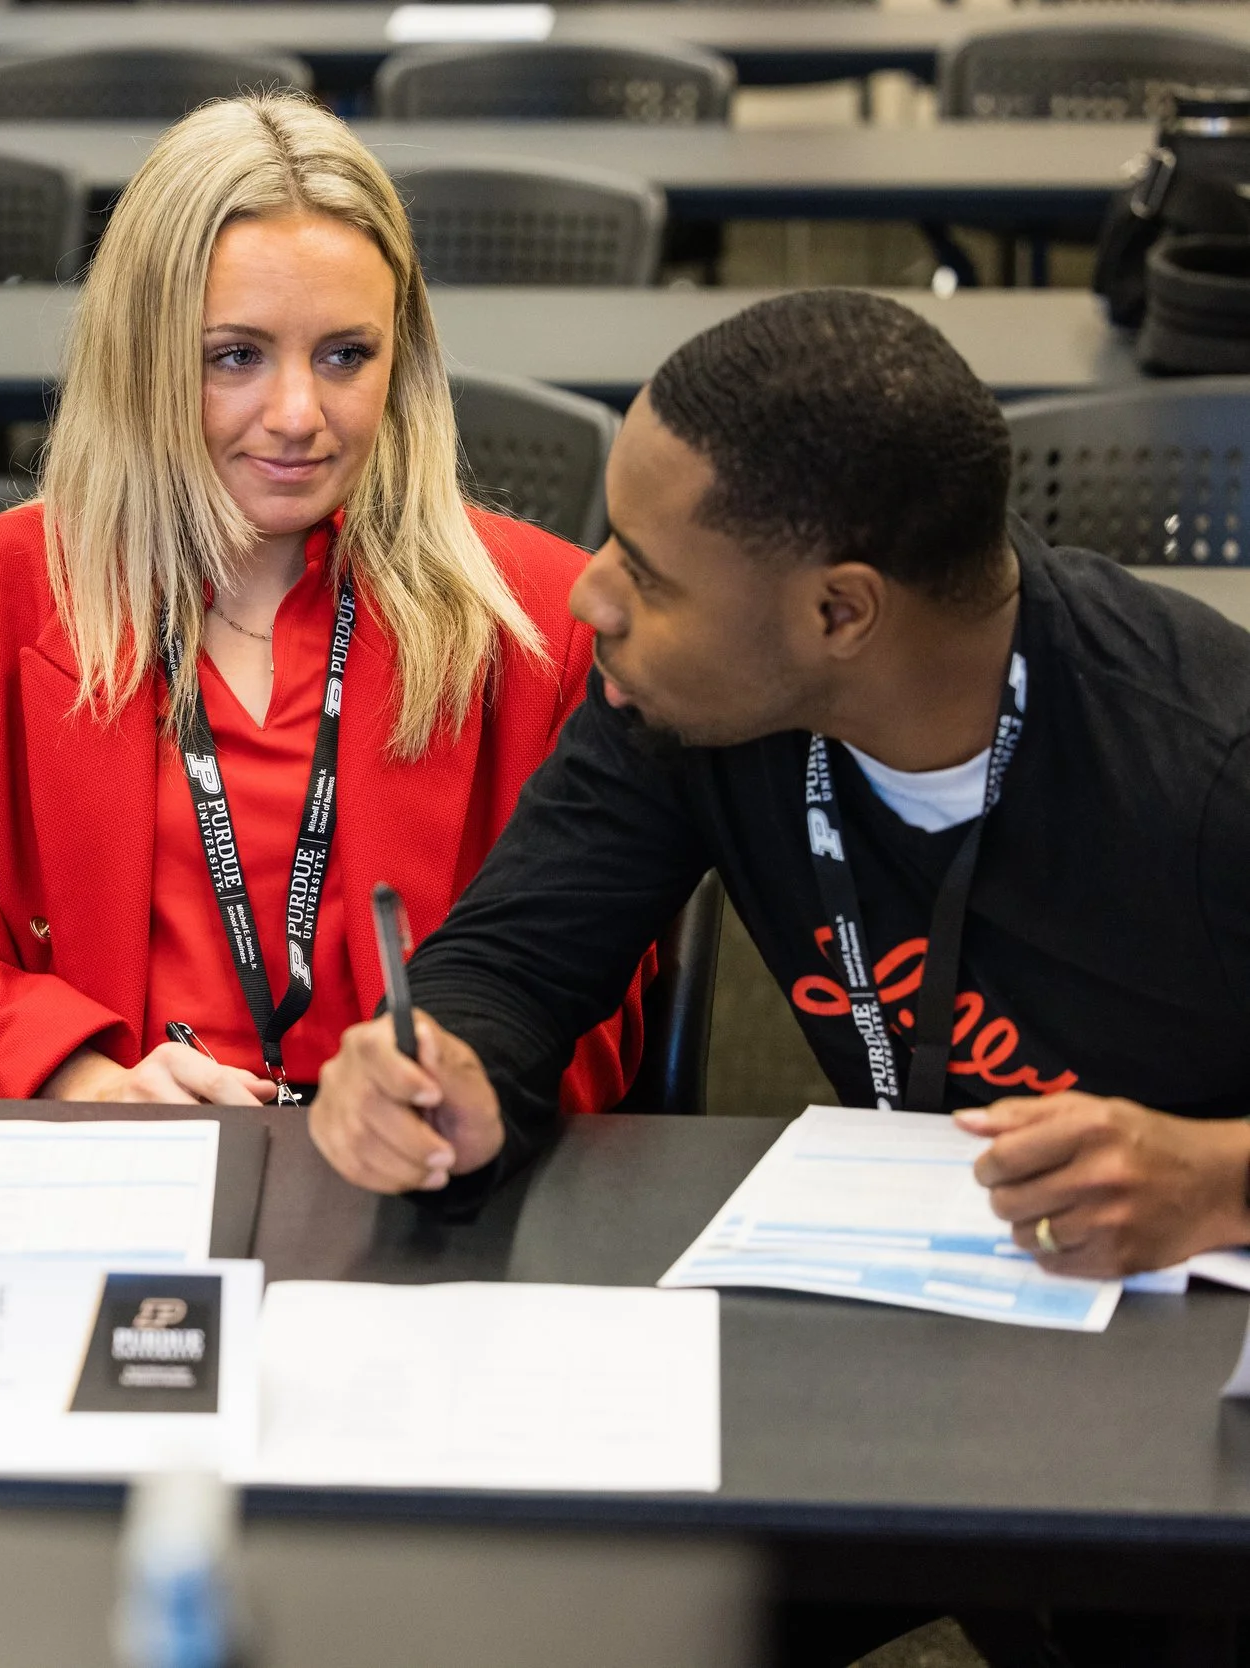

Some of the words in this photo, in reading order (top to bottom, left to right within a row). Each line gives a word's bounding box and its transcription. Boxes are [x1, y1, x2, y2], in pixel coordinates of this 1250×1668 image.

[323, 776, 336, 804] Business
[307, 805, 320, 832] Mitchell
[314, 776, 326, 799] Daniels,
[322, 802, 331, 811] of
[317, 811, 329, 834] School
[207, 797, 243, 889] PURDUE
[287, 848, 316, 938] PURDUE
[226, 905, 239, 927] School
[236, 904, 249, 929] Mitchell
[233, 927, 242, 935] of
[243, 929, 251, 937] E.
[235, 935, 247, 964] Business
[245, 936, 256, 963] Daniels,
[851, 1003, 890, 1095] PURDUE
